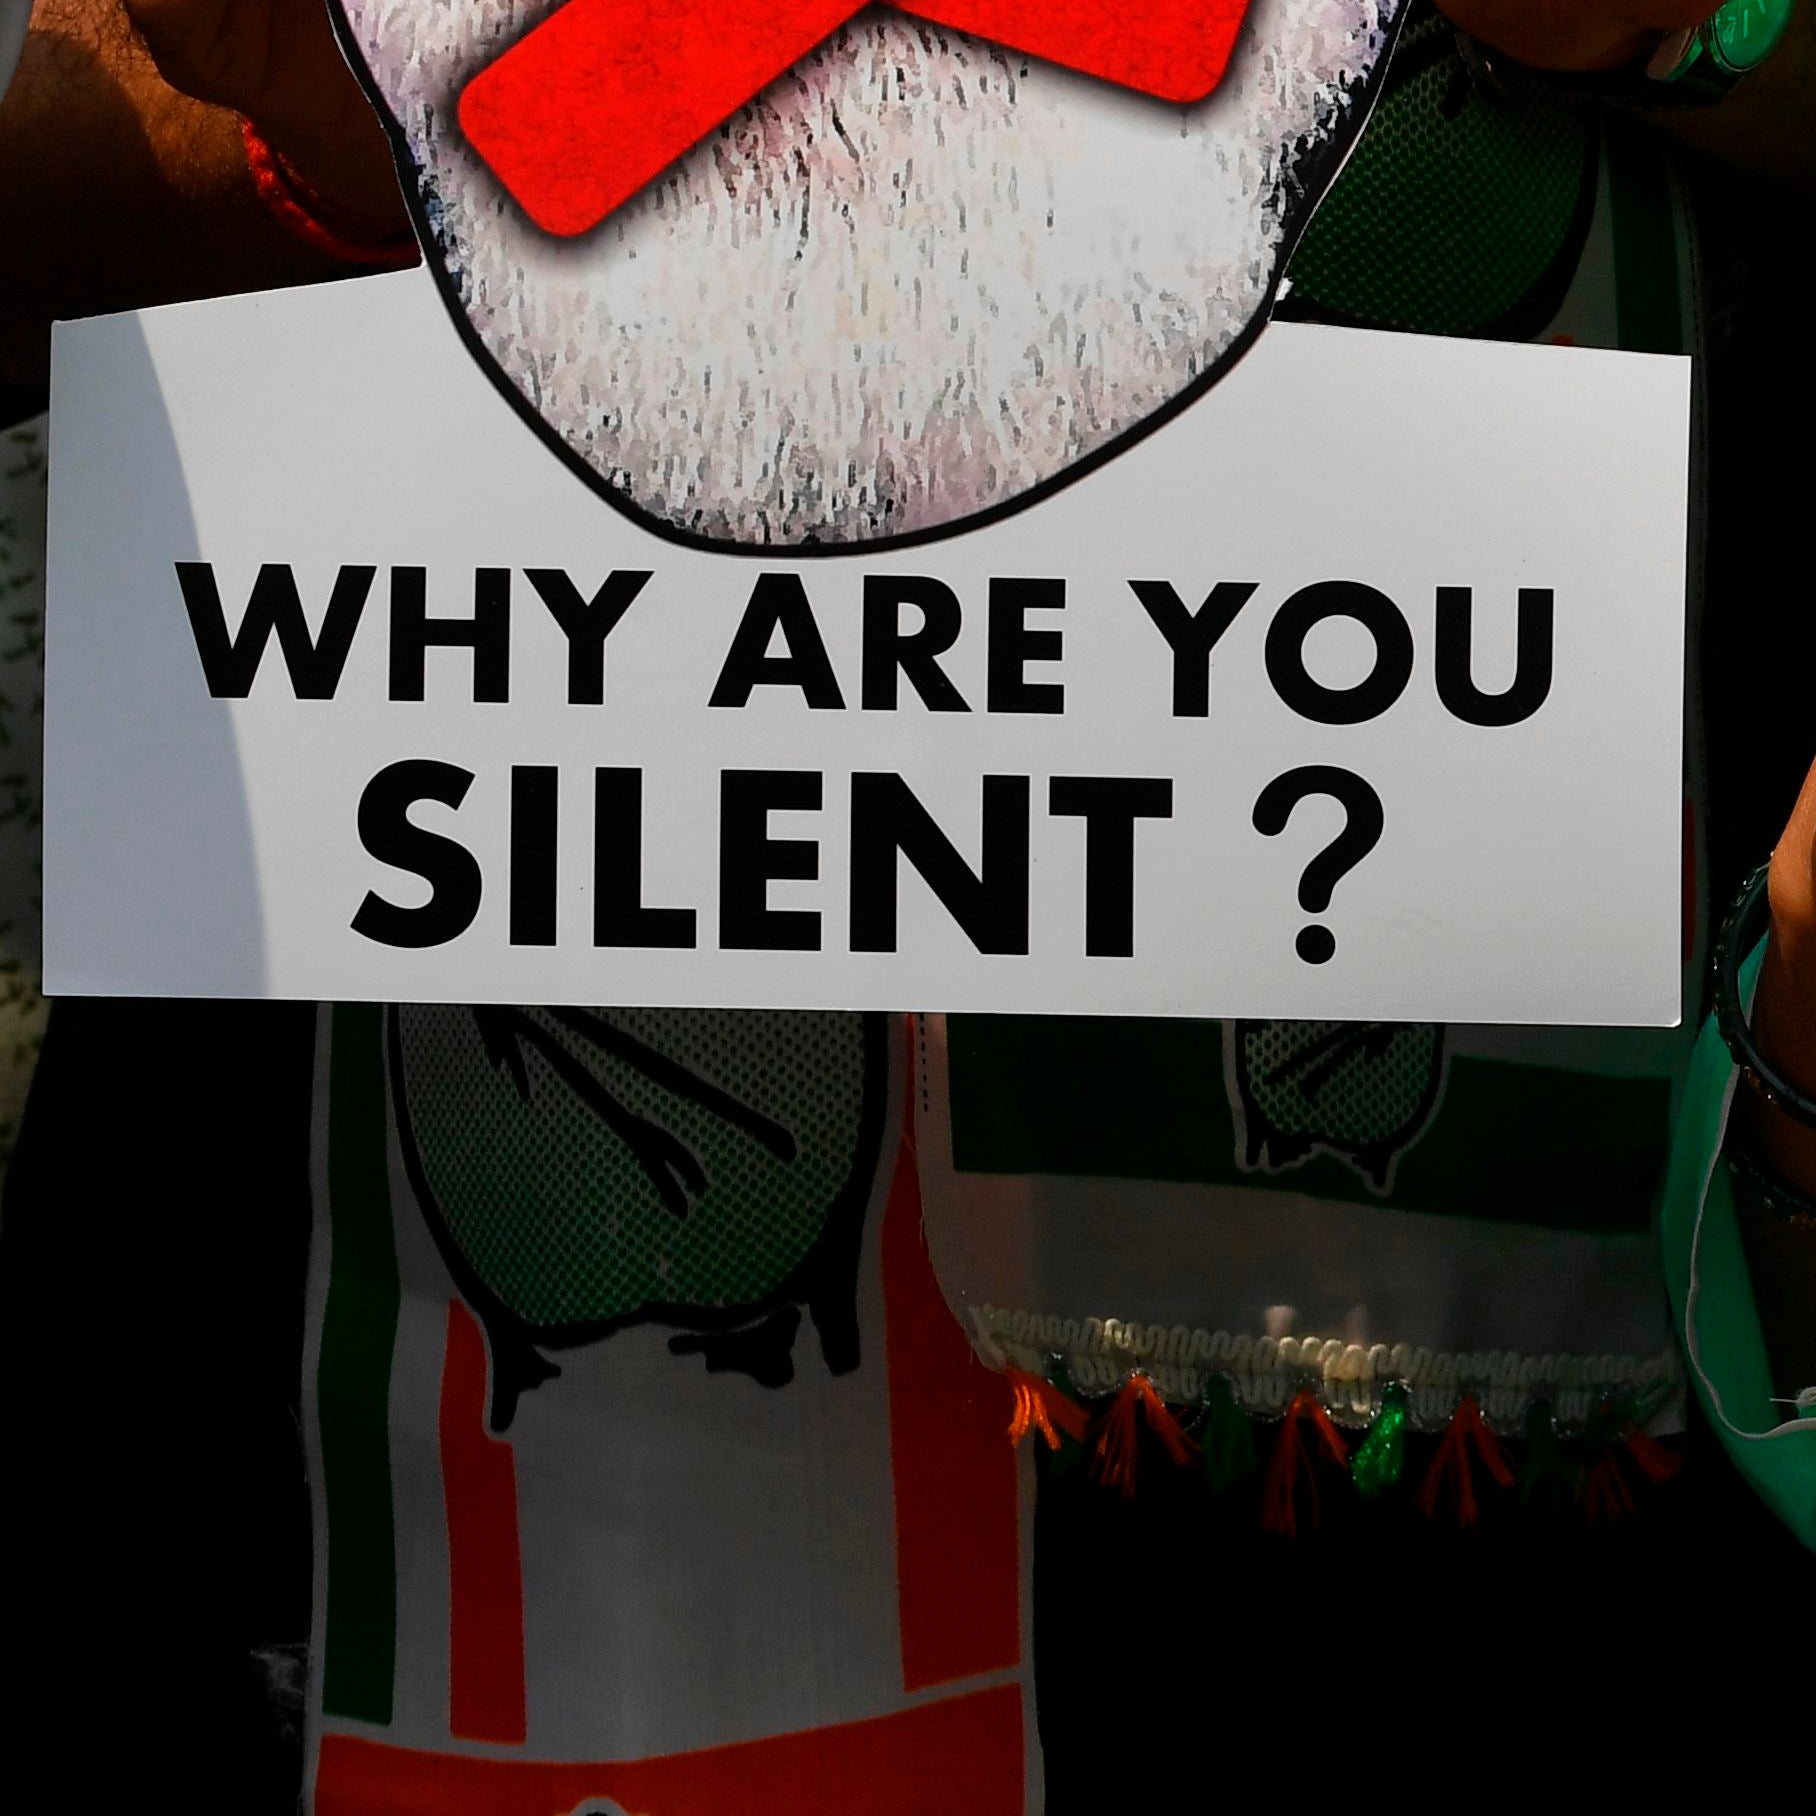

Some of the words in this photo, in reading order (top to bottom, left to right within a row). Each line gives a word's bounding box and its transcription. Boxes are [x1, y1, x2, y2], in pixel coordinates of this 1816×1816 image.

[174, 561, 655, 706] WHY
[707, 572, 1066, 715] ARE
[1127, 579, 1554, 727] YOU
[350, 759, 1174, 958] SILENT
[1252, 764, 1384, 965] ?
